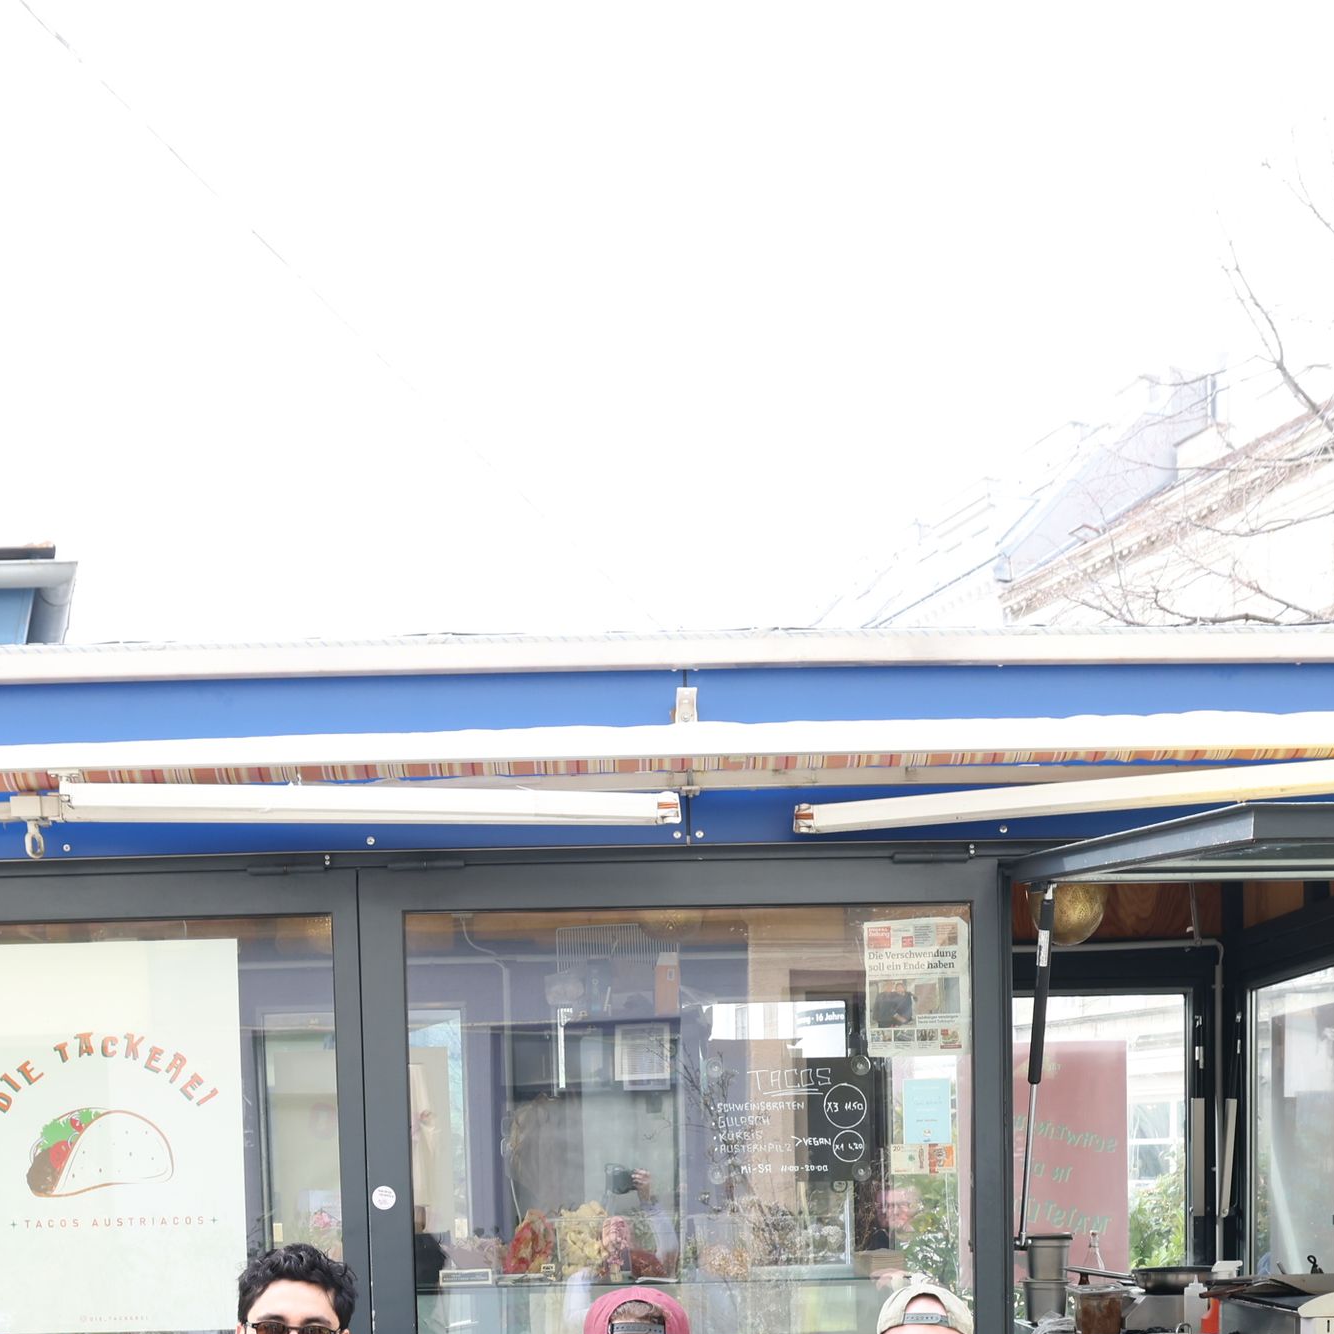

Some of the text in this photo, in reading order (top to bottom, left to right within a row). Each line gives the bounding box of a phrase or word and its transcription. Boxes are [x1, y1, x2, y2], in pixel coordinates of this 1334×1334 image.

[868, 949, 957, 960] Die Verschwendung
[868, 960, 955, 972] soll ein Ende haben
[53, 1031, 219, 1106] TACKEREI
[747, 1067, 832, 1091] TACOS
[803, 1137, 832, 1147] VEGAN
[25, 1216, 205, 1229] TACOS AUSTRIACOS
